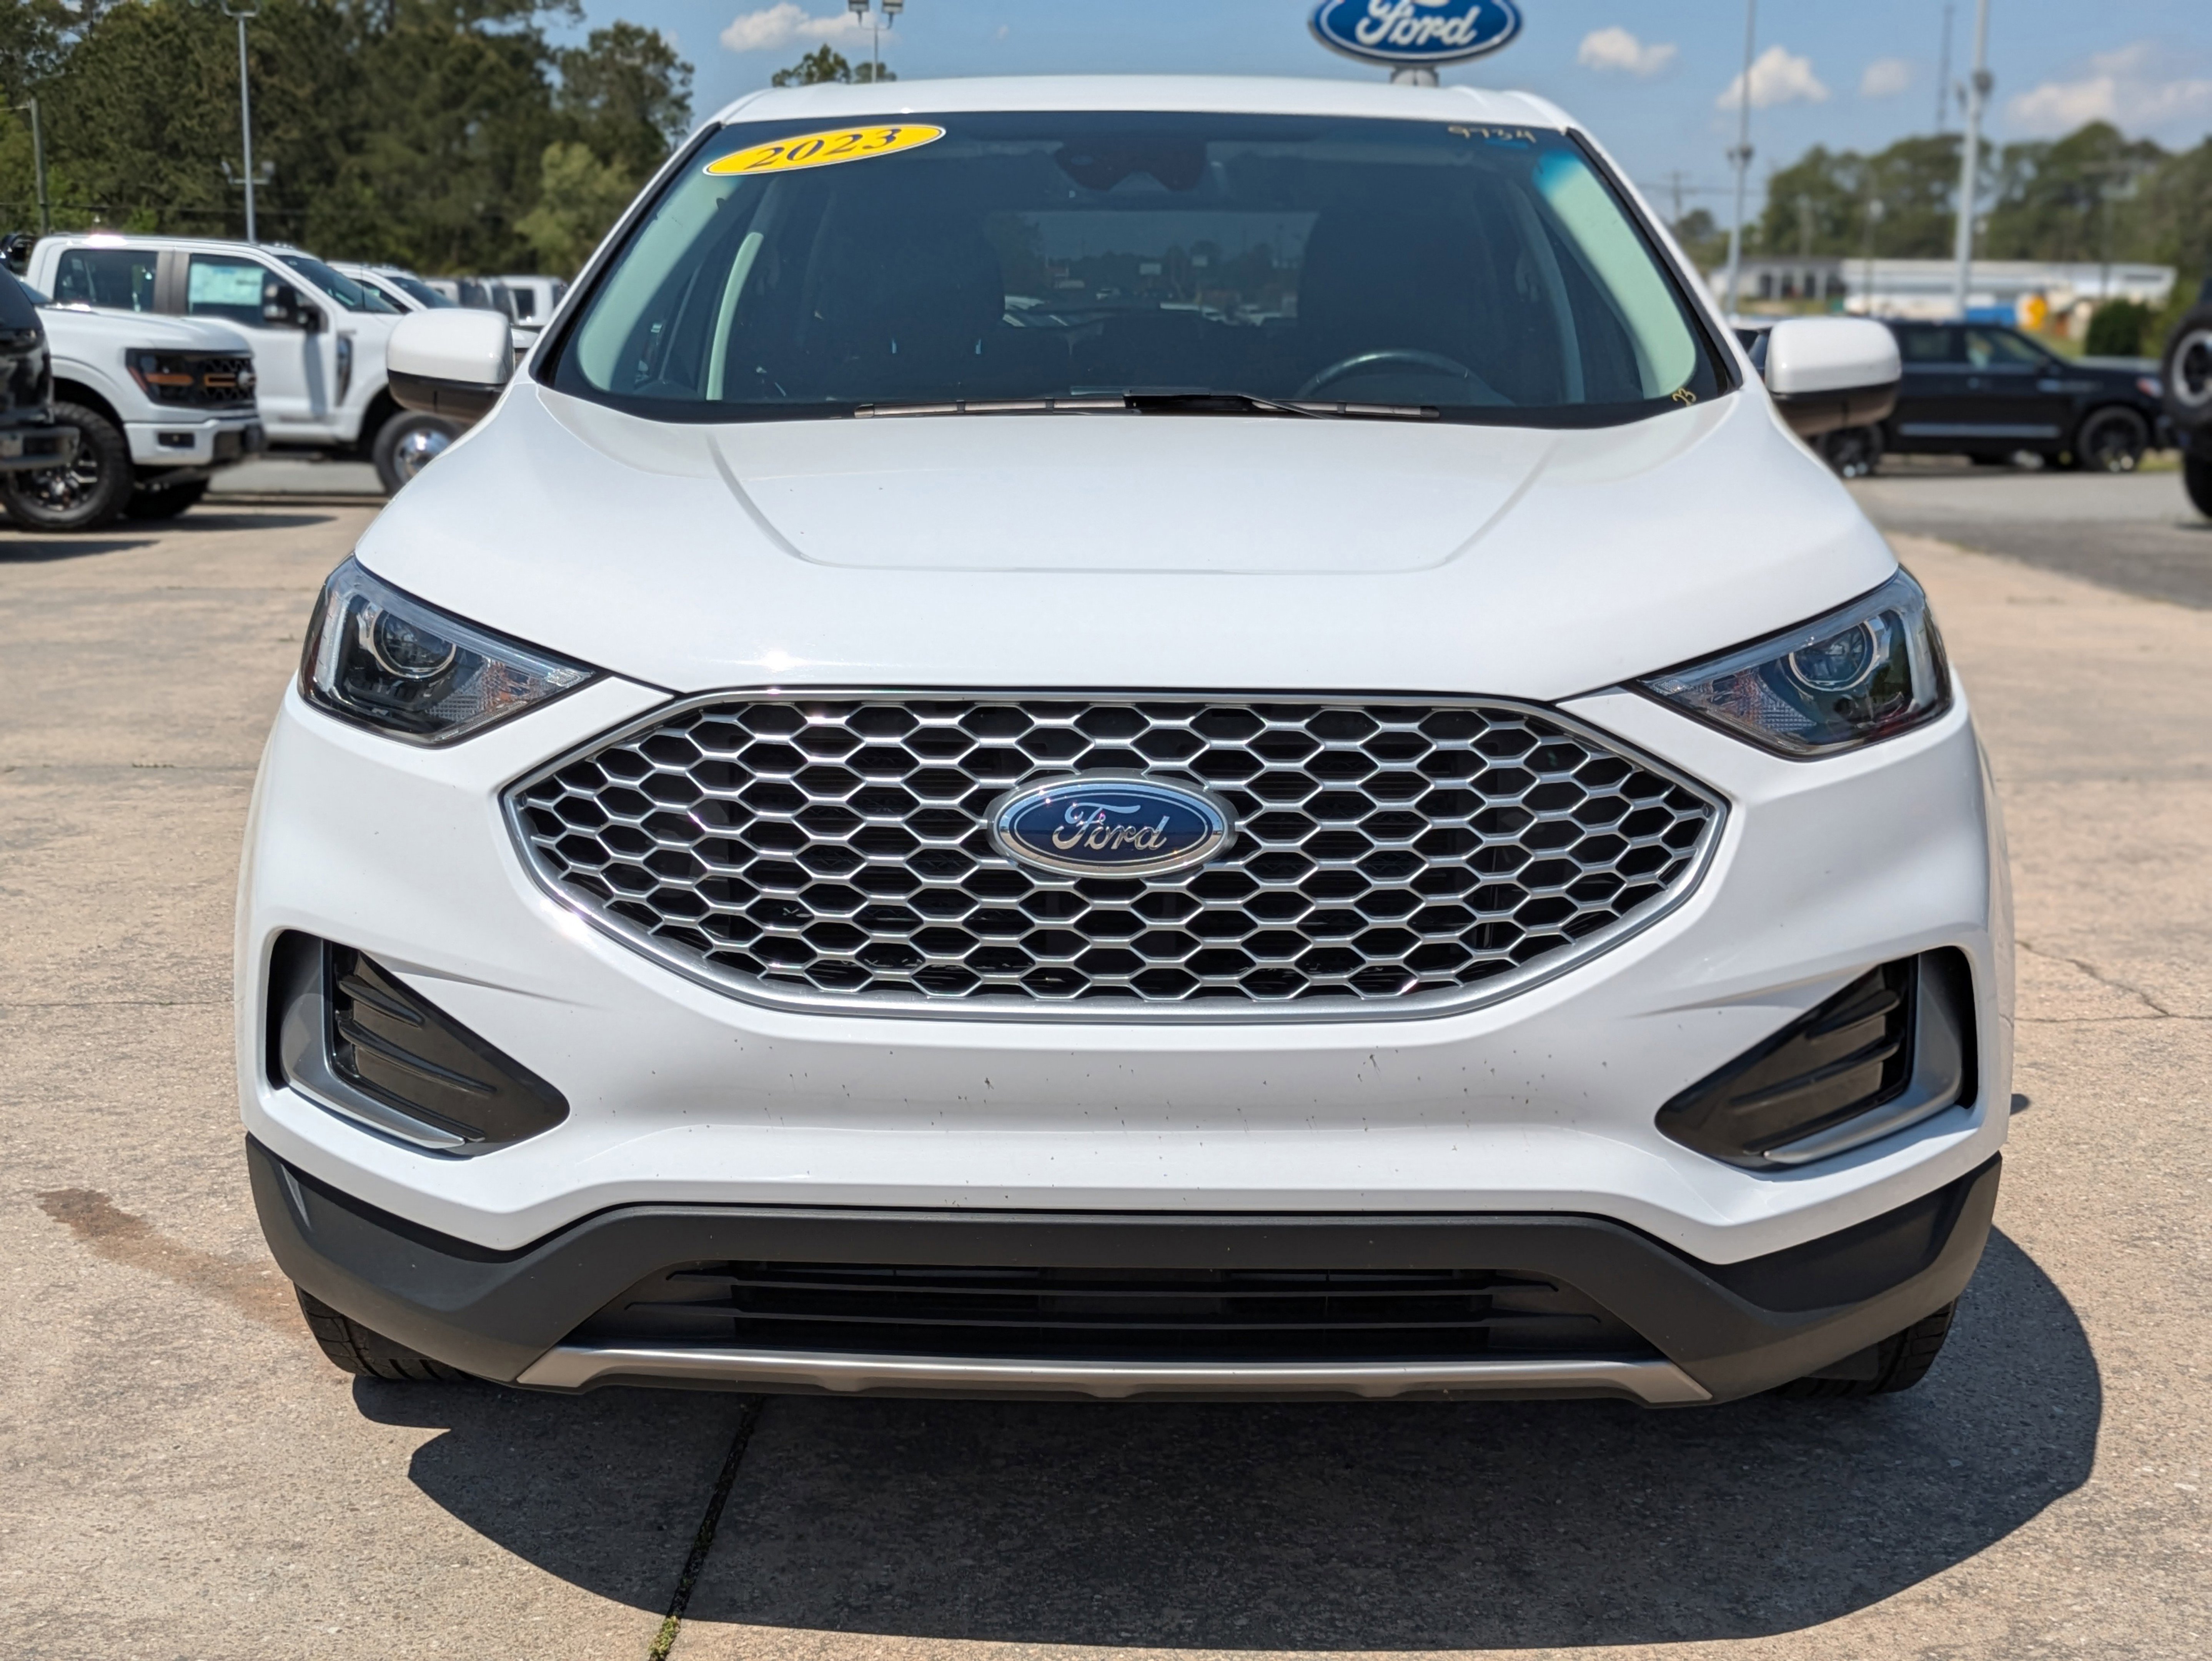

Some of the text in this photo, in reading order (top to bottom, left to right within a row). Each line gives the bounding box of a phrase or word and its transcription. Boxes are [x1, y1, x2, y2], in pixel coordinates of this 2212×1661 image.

[1355, 0, 1481, 46] Ford
[744, 128, 902, 170] 2023
[1052, 802, 1171, 850] Ford
